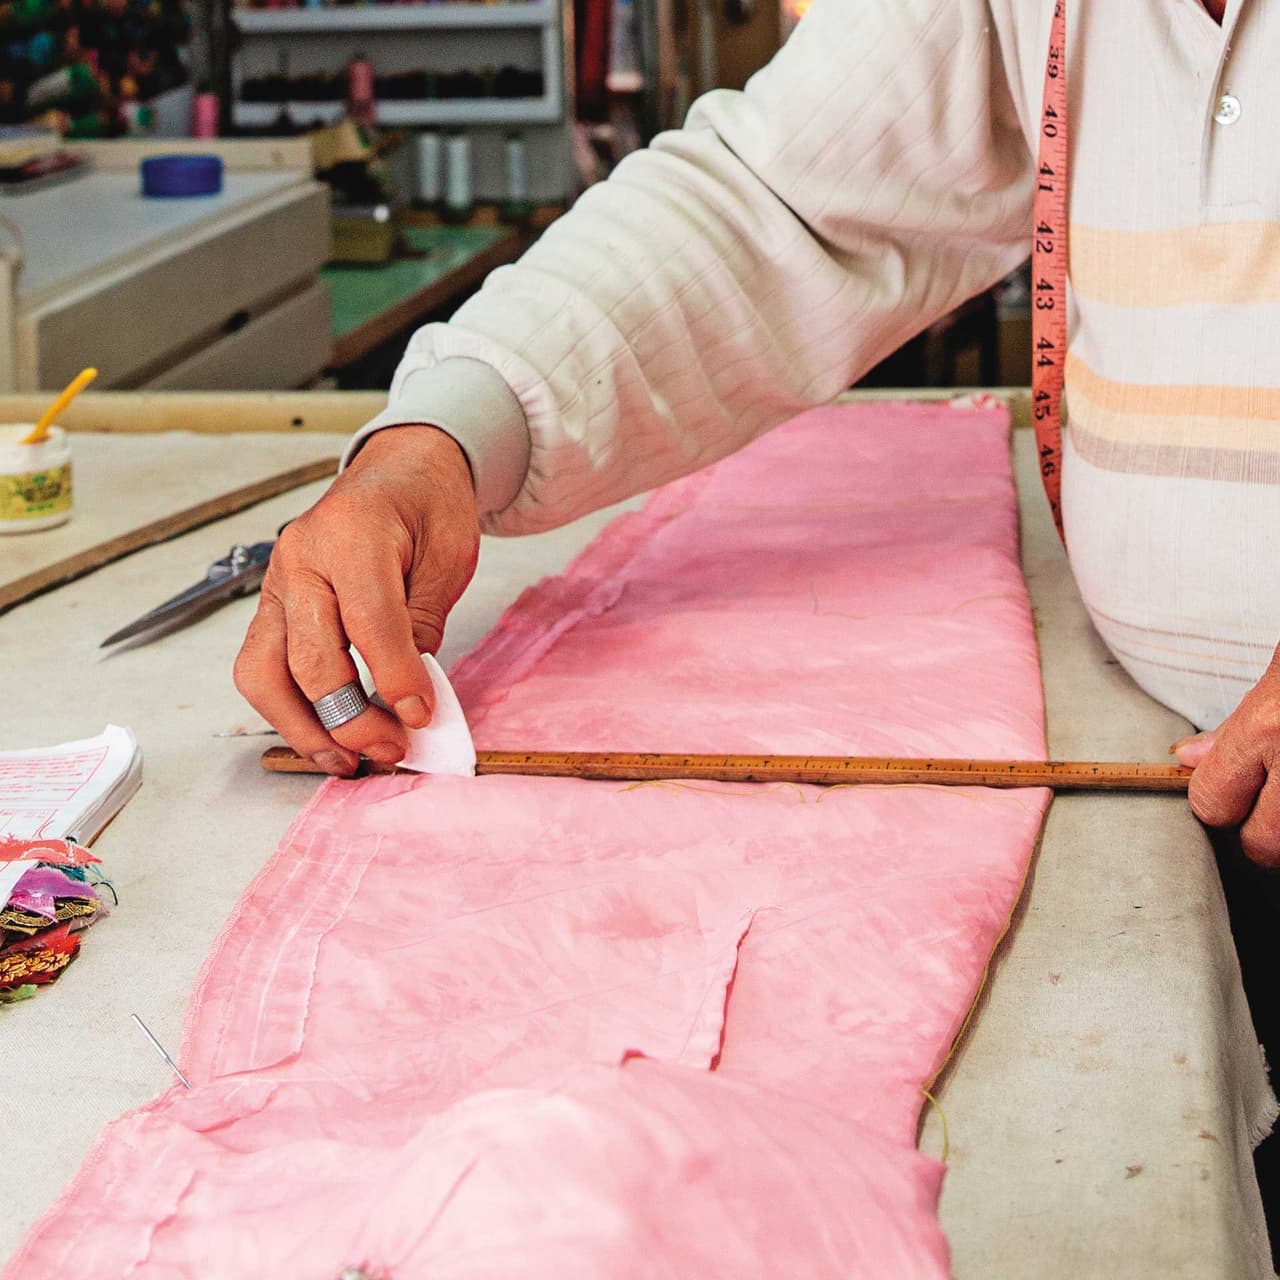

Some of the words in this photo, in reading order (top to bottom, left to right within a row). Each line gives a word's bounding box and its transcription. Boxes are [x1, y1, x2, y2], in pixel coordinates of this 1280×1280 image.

[1048, 45, 1060, 79] 39
[1043, 104, 1058, 138] 40
[1038, 161, 1056, 193] 41
[1036, 220, 1054, 255] 42
[1036, 278, 1054, 311] 43
[1037, 337, 1054, 368] 44
[1035, 389, 1051, 421] 45
